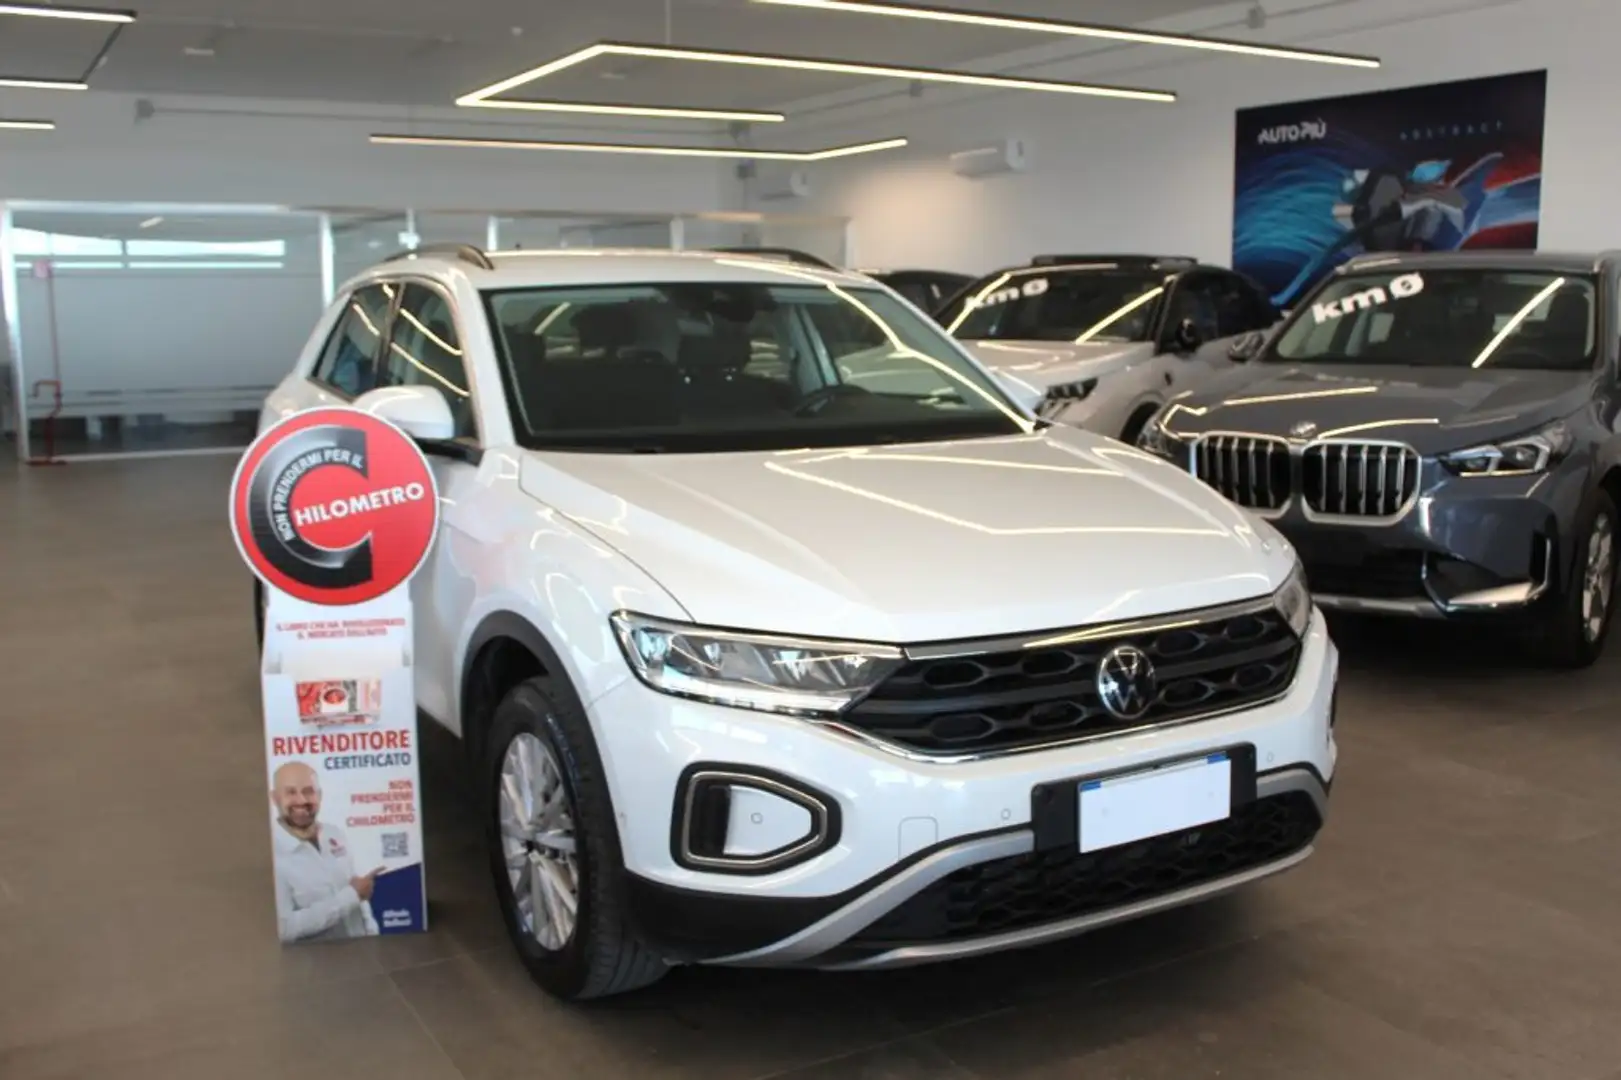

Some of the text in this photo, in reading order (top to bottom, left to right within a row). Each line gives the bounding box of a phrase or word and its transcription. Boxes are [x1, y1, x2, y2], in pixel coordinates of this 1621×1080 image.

[1311, 286, 1387, 324] km
[323, 449, 352, 463] PER
[272, 730, 412, 756] RIVENDITORE
[324, 752, 412, 770] CERTIFICATO
